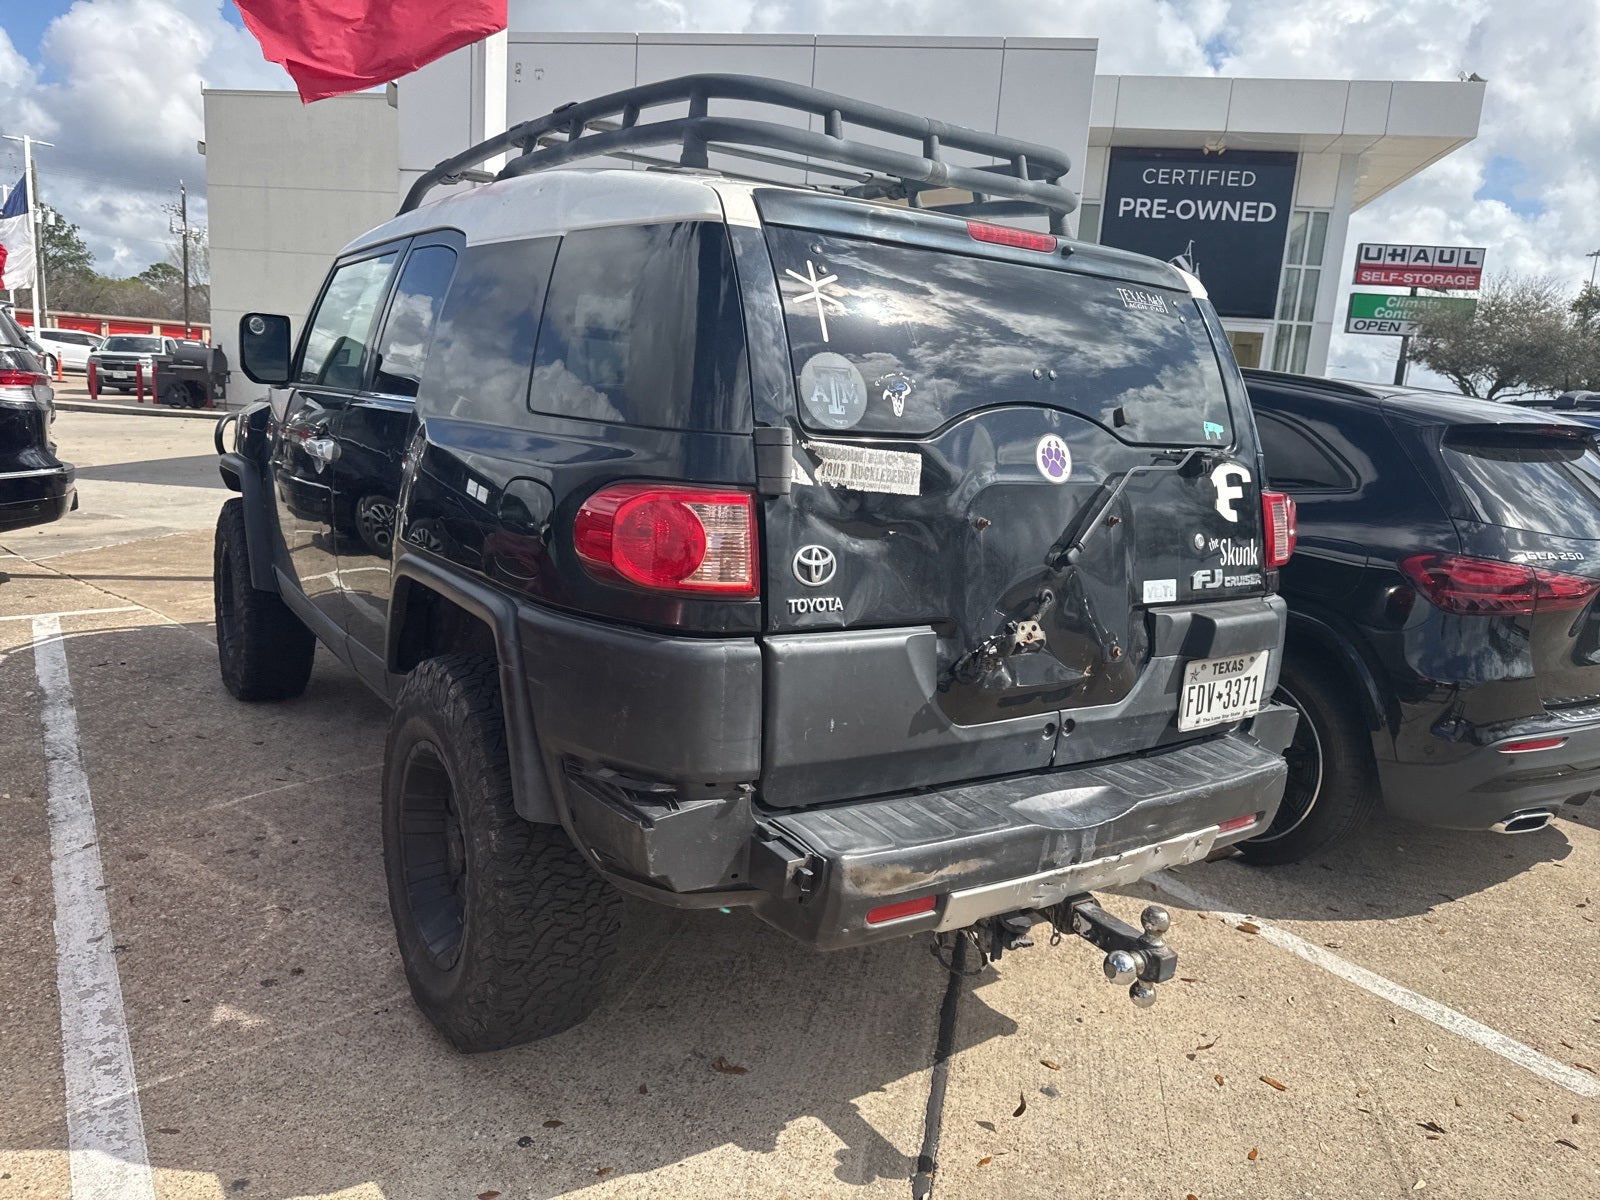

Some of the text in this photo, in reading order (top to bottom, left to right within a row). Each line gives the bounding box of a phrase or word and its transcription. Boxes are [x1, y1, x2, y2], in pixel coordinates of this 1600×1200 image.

[1142, 168, 1257, 187] CERTIFIED
[1118, 197, 1277, 223] PRE-OWNED
[1361, 270, 1476, 286] SELF-STORAGE
[1354, 319, 1402, 332] OPEN
[1208, 537, 1258, 566] the Skunk
[1526, 551, 1585, 561] GLA 250
[1192, 568, 1262, 590] FJ CRUISER
[788, 597, 844, 614] TOYOTA
[1212, 659, 1244, 675] TEXAS
